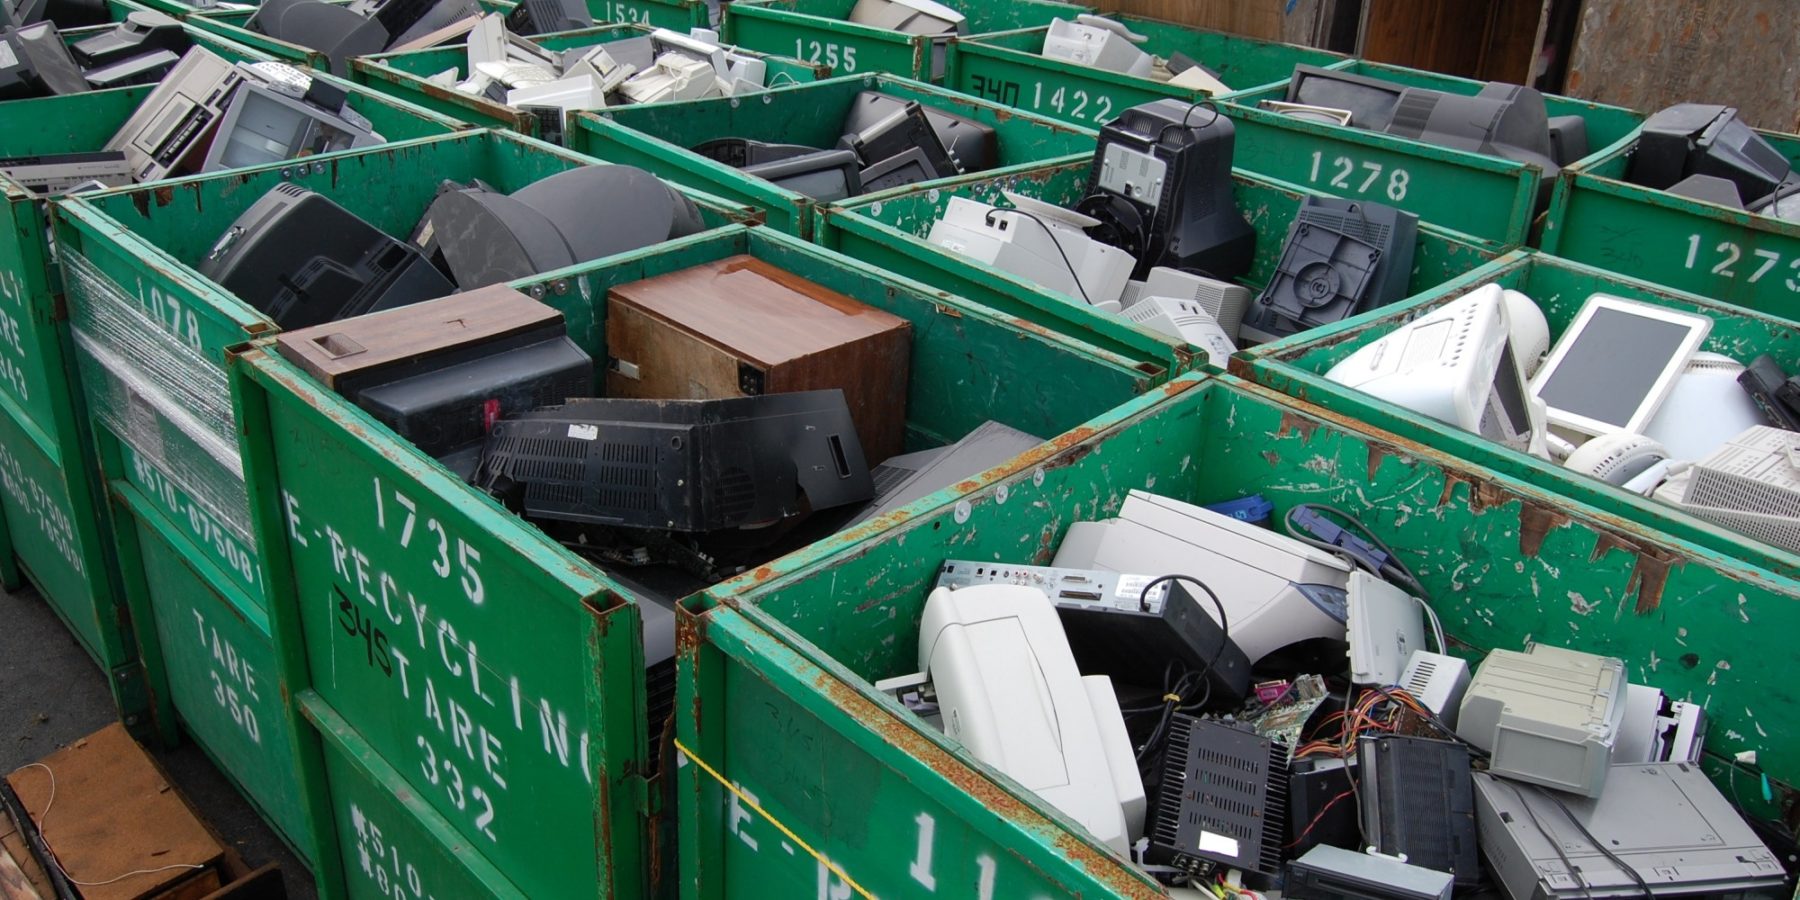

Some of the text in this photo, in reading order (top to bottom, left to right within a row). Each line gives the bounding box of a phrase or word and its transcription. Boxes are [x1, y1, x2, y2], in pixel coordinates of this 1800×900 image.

[795, 38, 857, 73] 1255
[1034, 81, 1112, 126] 1422
[1310, 151, 1410, 201] 1278
[137, 276, 203, 354] 1078
[373, 476, 485, 605] 1735
[192, 607, 260, 703] TARE
[210, 669, 261, 744] 350
[392, 646, 508, 790] TARE
[417, 734, 497, 843] 332
[909, 811, 1050, 900] 11
